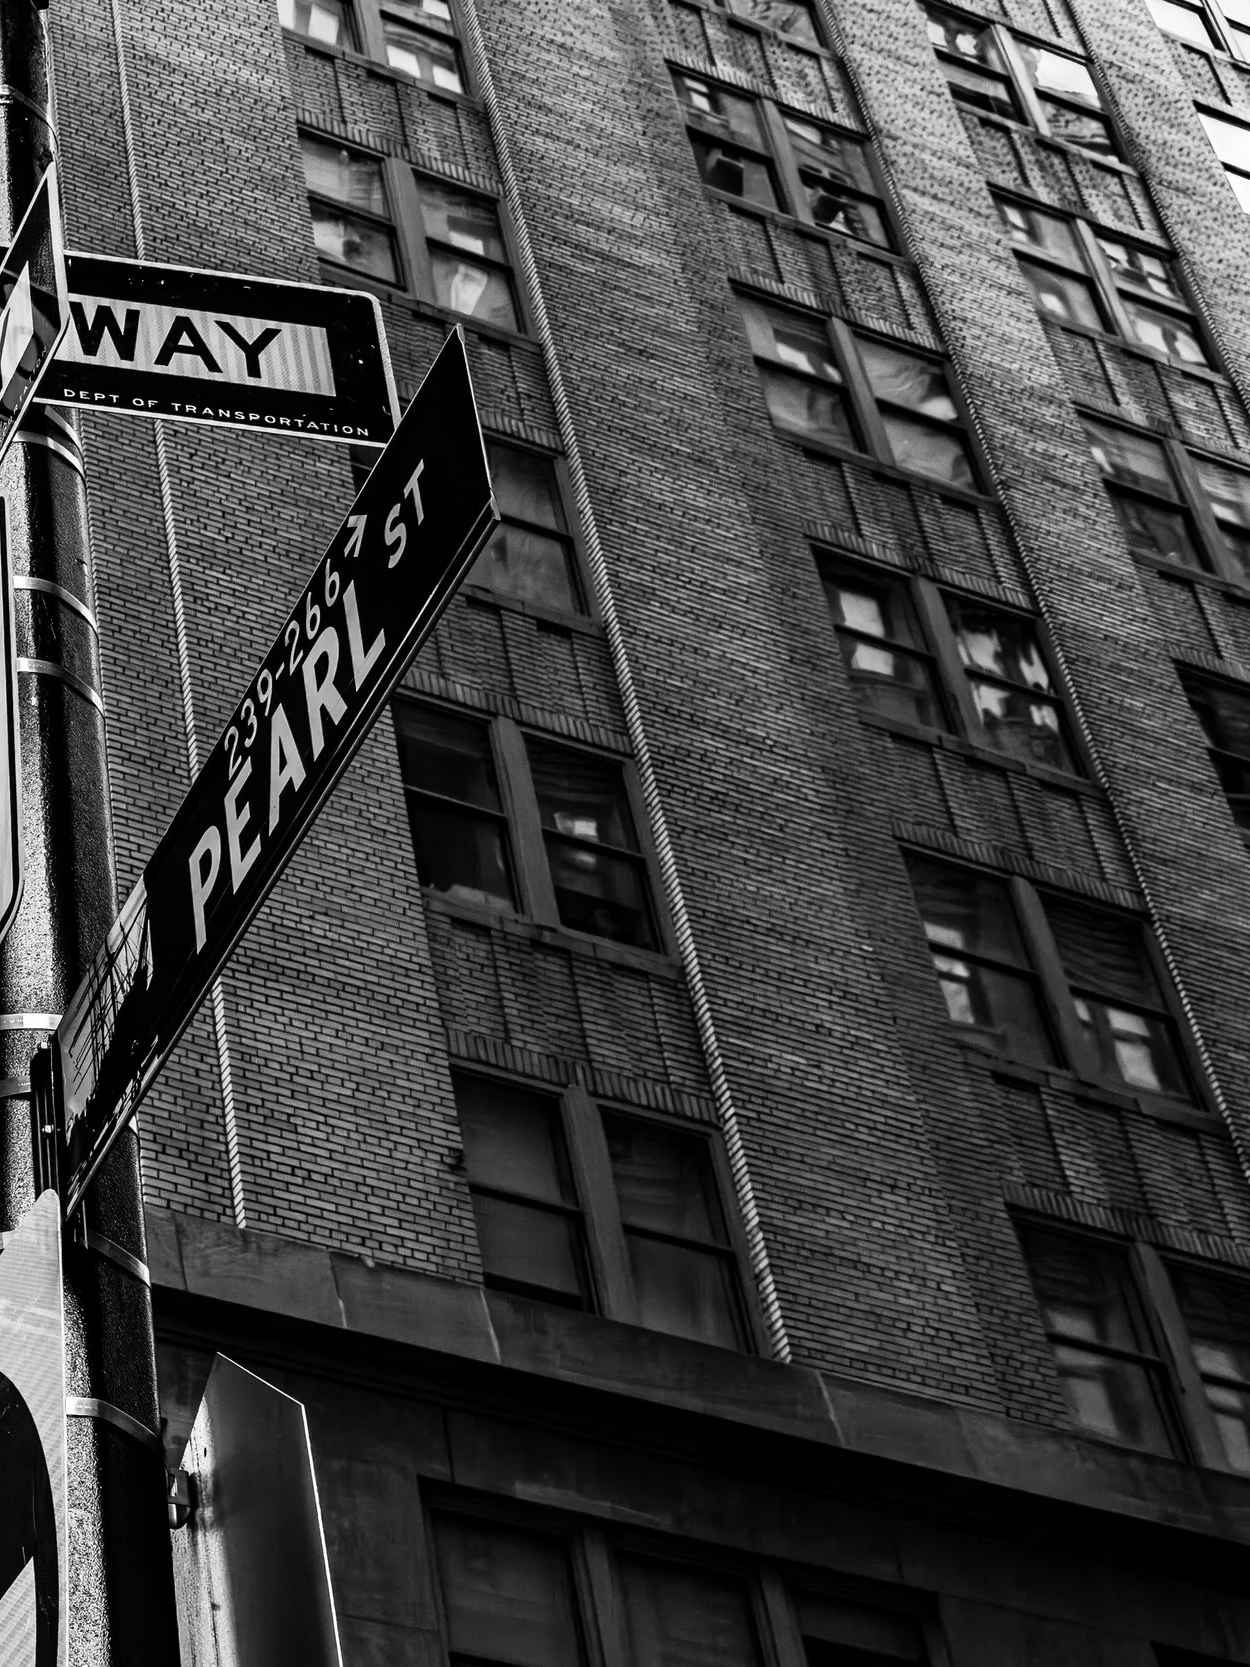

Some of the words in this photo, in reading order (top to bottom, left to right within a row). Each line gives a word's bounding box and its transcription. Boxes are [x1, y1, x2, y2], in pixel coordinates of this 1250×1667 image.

[62, 387, 120, 404] DEPT
[132, 397, 158, 408] OF
[170, 402, 370, 438] TRANSPORTATION
[68, 300, 283, 380] WAY
[188, 578, 386, 955] PEARL
[383, 457, 425, 569] ST
[223, 557, 341, 782] 239-266
